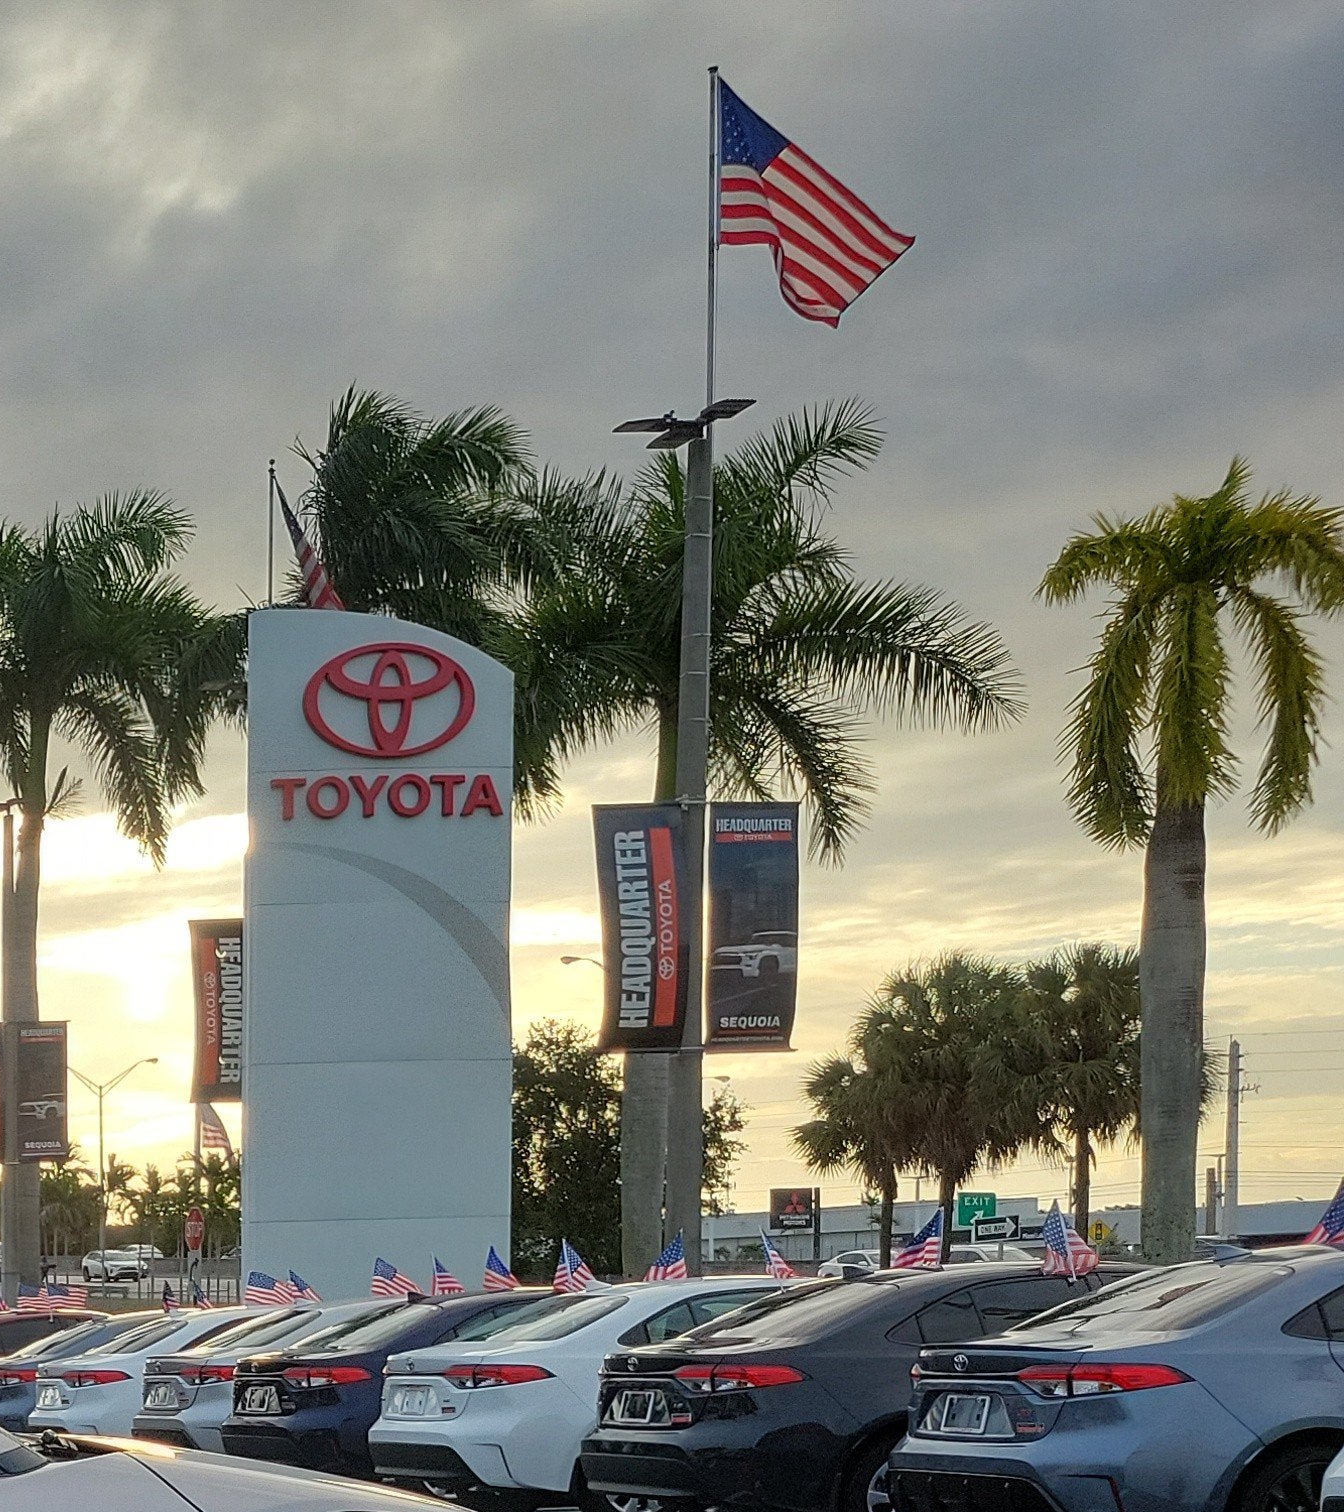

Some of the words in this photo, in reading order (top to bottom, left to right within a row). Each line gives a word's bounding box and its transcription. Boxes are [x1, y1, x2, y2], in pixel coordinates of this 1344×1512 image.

[270, 774, 504, 821] TOYOTA
[715, 819, 792, 833] HEADQUARTER
[614, 830, 656, 1028] HEADQUARTER
[658, 878, 674, 954] TOYOTA
[205, 992, 216, 1045] TOYOTA
[219, 937, 243, 1084] HEADQUARTER
[719, 1016, 781, 1029] SEQUOIA
[964, 1197, 990, 1206] EXIT
